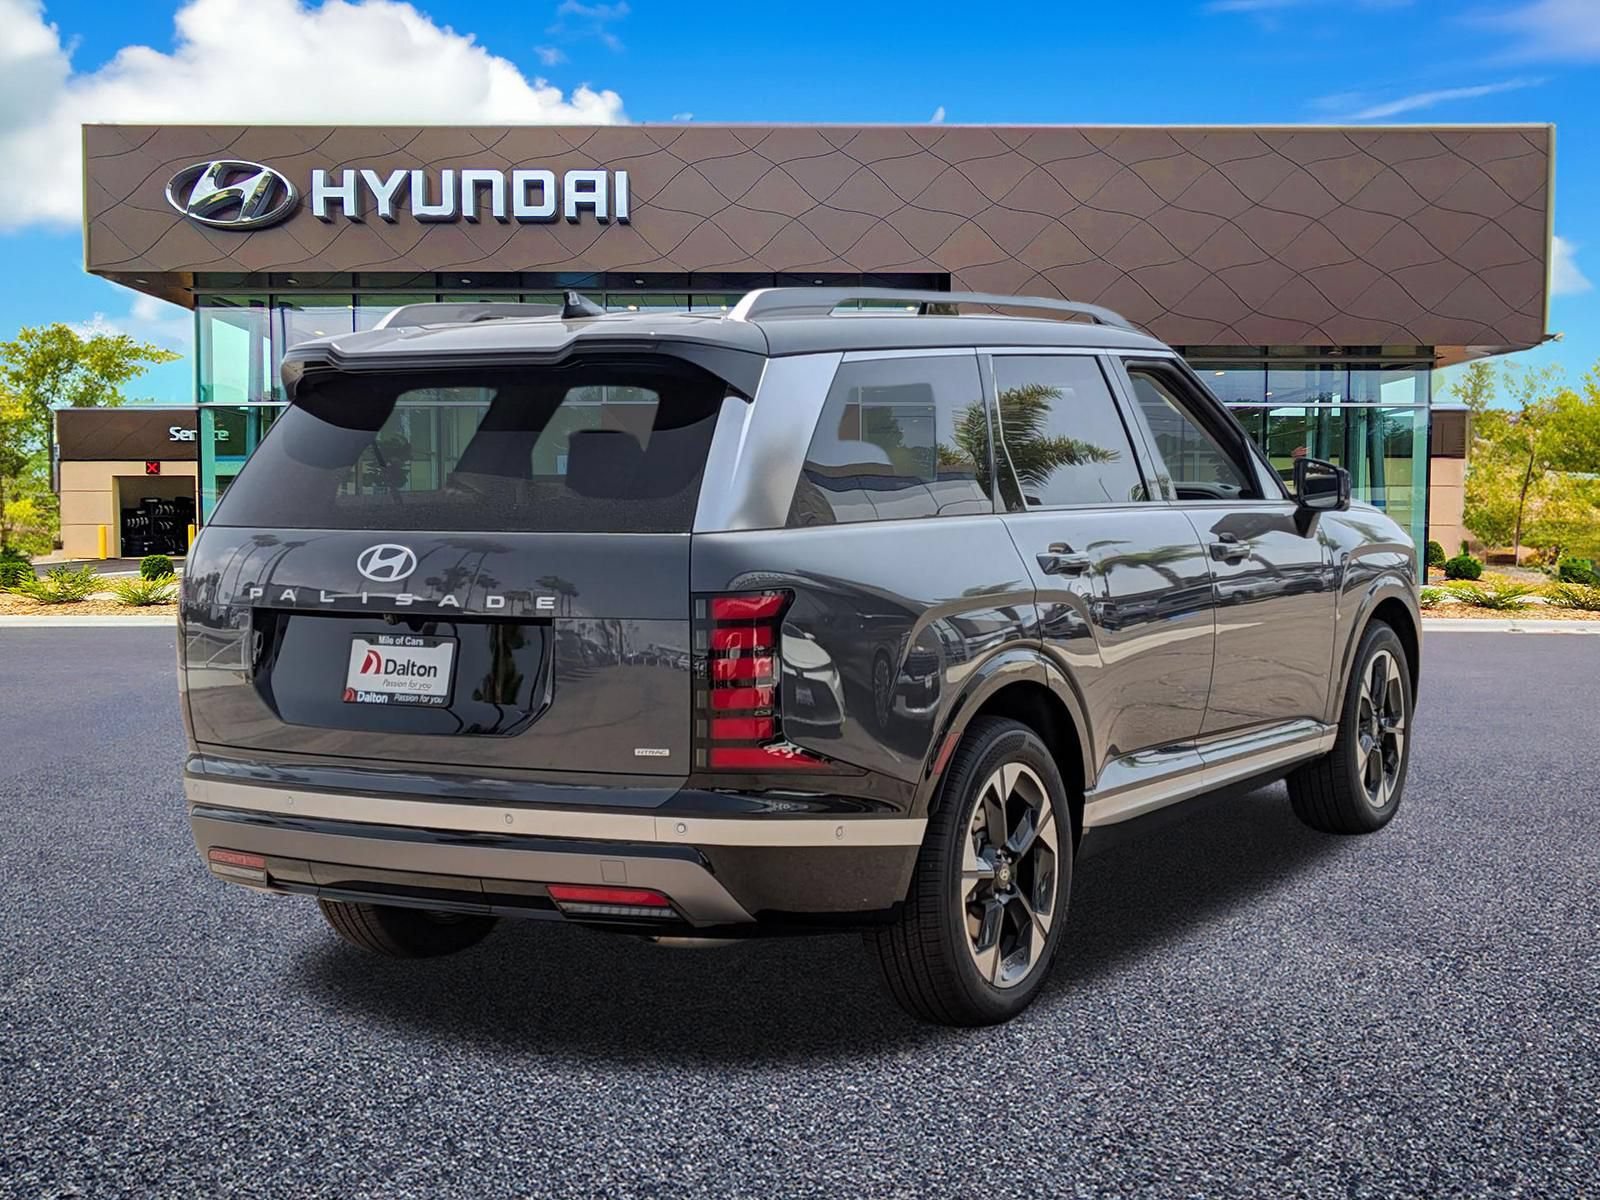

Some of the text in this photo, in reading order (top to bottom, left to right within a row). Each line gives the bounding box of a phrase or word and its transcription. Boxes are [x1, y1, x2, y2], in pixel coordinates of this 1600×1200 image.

[312, 169, 630, 222] HYUNDAI
[249, 587, 556, 609] PALISADE
[378, 635, 424, 646] Mile of Cars
[384, 658, 438, 678] Dalton
[382, 679, 433, 690] Passion for you
[356, 691, 444, 705] Dalton Passion for you
